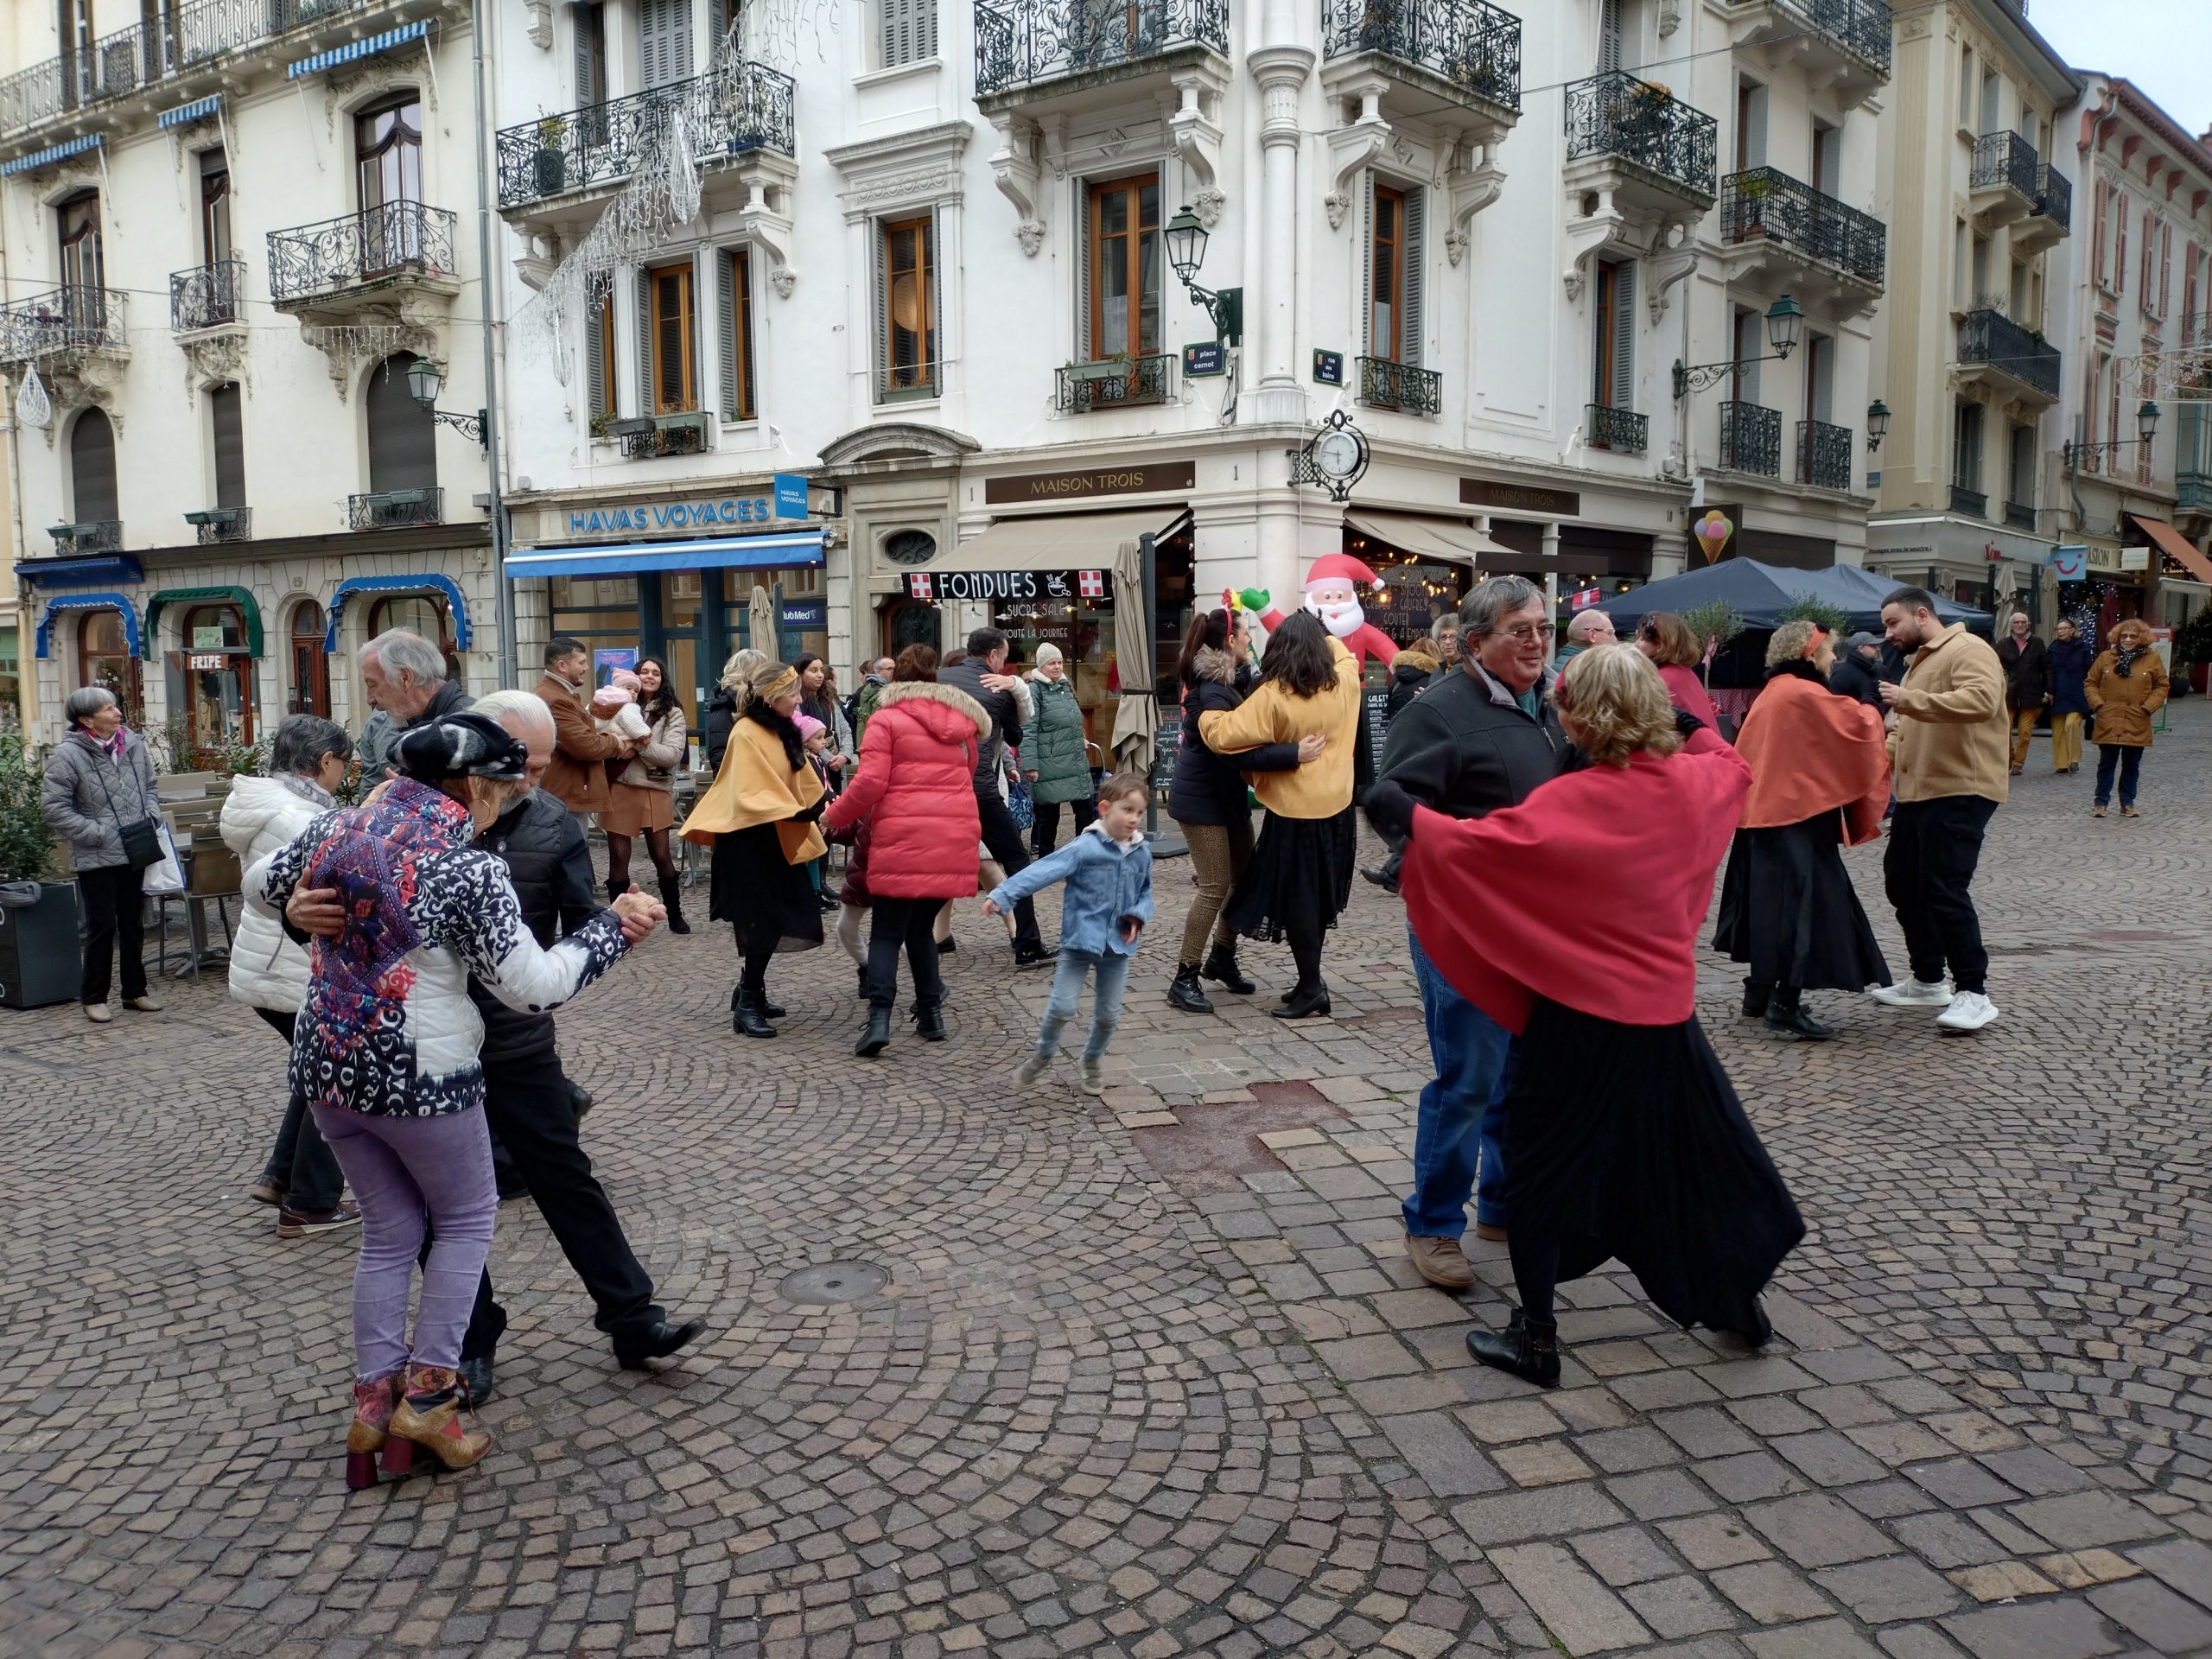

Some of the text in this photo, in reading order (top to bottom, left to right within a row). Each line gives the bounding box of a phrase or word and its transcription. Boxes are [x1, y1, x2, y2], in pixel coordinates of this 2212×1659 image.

[1199, 350, 1217, 359] place
[1193, 360, 1215, 369] carnot
[1031, 472, 1144, 495] MAISON TROIS
[780, 496, 806, 505] VOYAGES
[1489, 487, 1555, 507] MAISON TROIS
[570, 499, 769, 533] HAVAS VOYAGES
[2086, 547, 2111, 568] ASION
[938, 572, 1038, 599] FONDUES
[1027, 628, 1036, 639] LA
[191, 655, 222, 670] FRIPE
